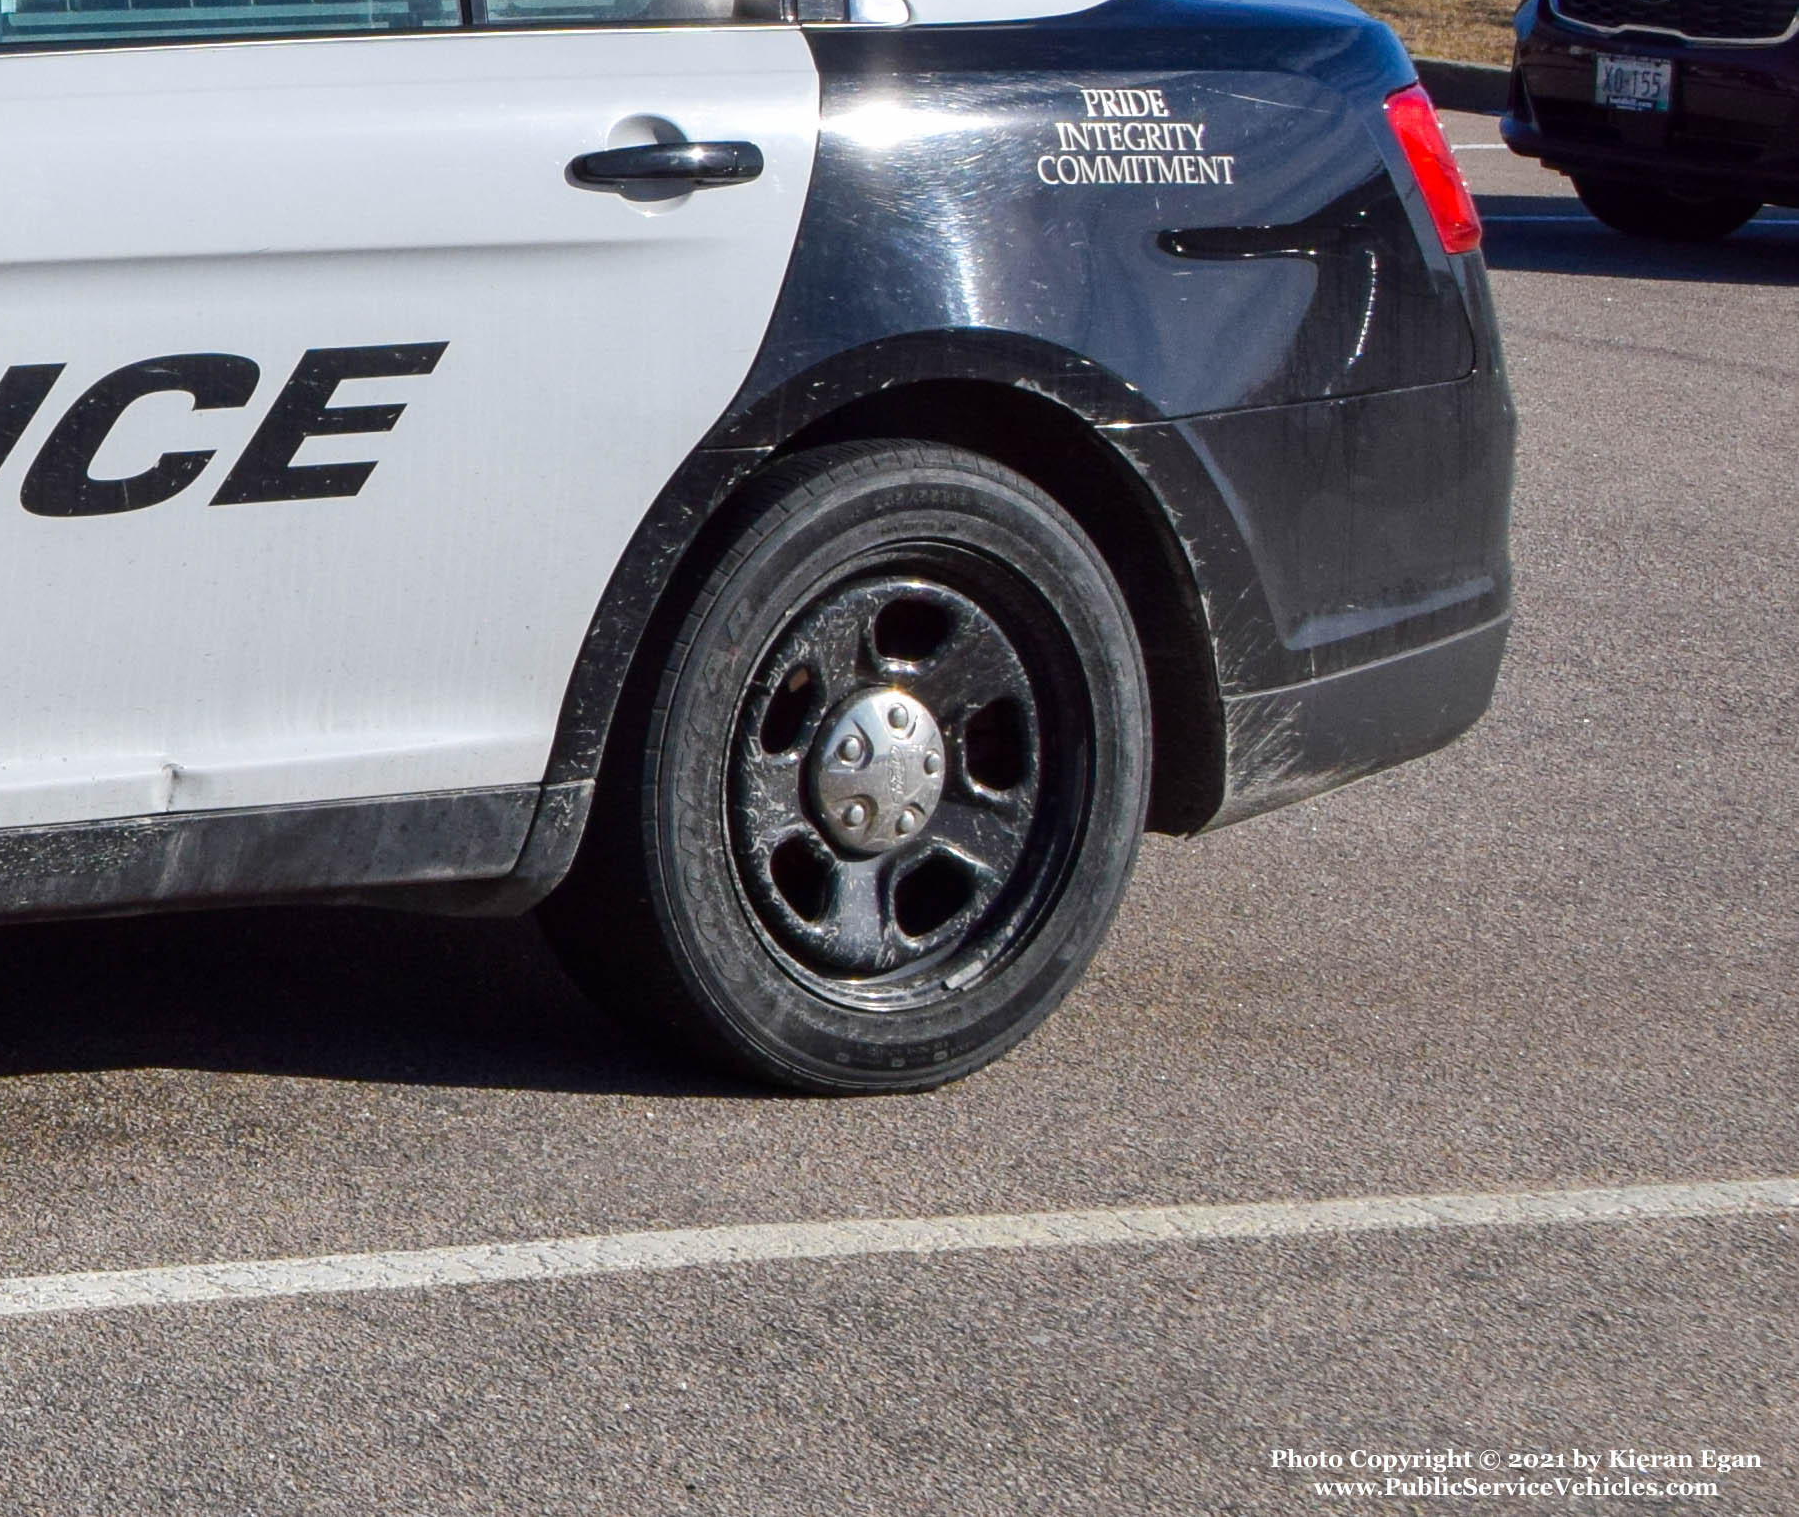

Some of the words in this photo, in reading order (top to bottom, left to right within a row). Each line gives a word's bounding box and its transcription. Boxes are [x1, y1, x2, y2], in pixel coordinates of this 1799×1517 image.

[1081, 89, 1171, 117] PRIDE
[1055, 122, 1206, 151] INTEGRITY
[1037, 155, 1234, 184] COMMITMENT
